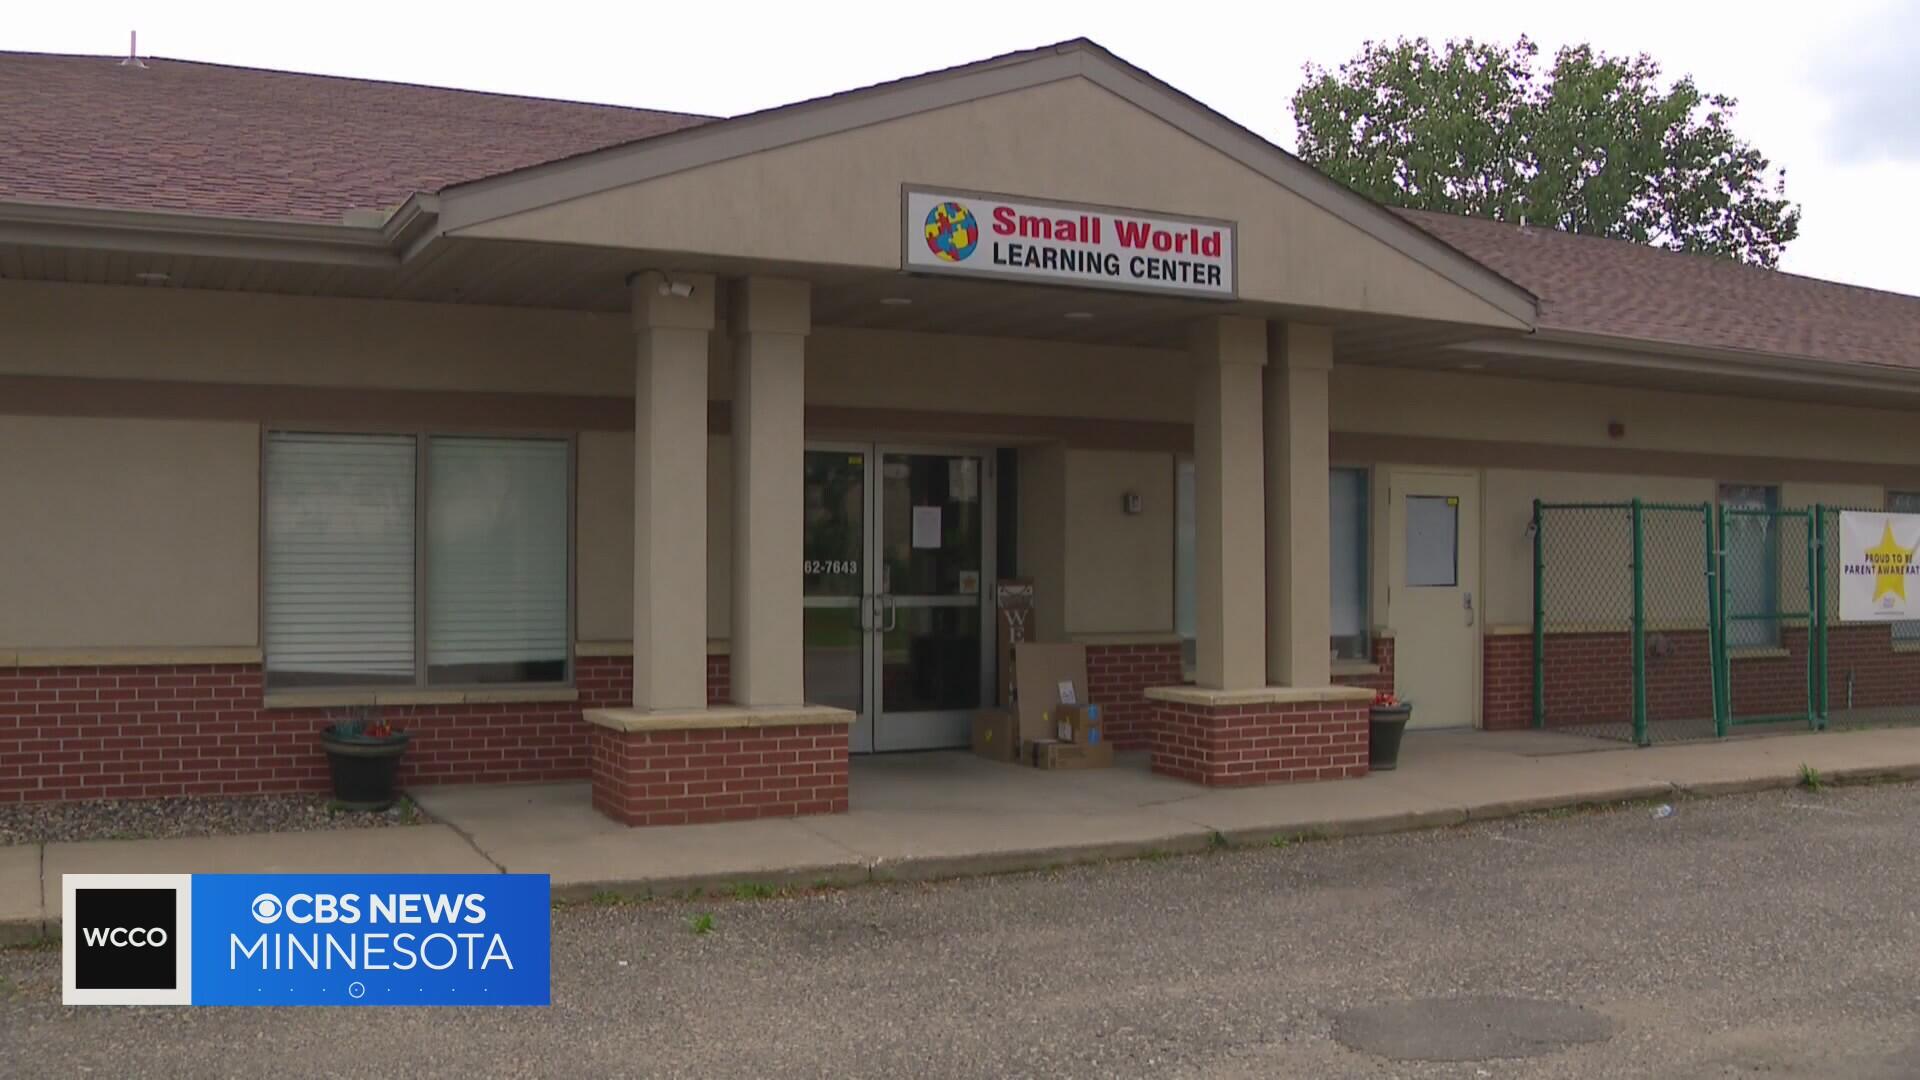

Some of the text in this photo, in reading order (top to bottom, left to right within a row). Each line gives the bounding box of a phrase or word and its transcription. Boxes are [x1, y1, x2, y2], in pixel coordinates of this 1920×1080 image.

[992, 206, 1221, 257] Small World
[993, 242, 1221, 286] LEARNING CENTER
[1844, 565, 1876, 575] PARENT
[1878, 565, 1904, 575] AWARE
[1864, 553, 1913, 563] PROUD TO BE
